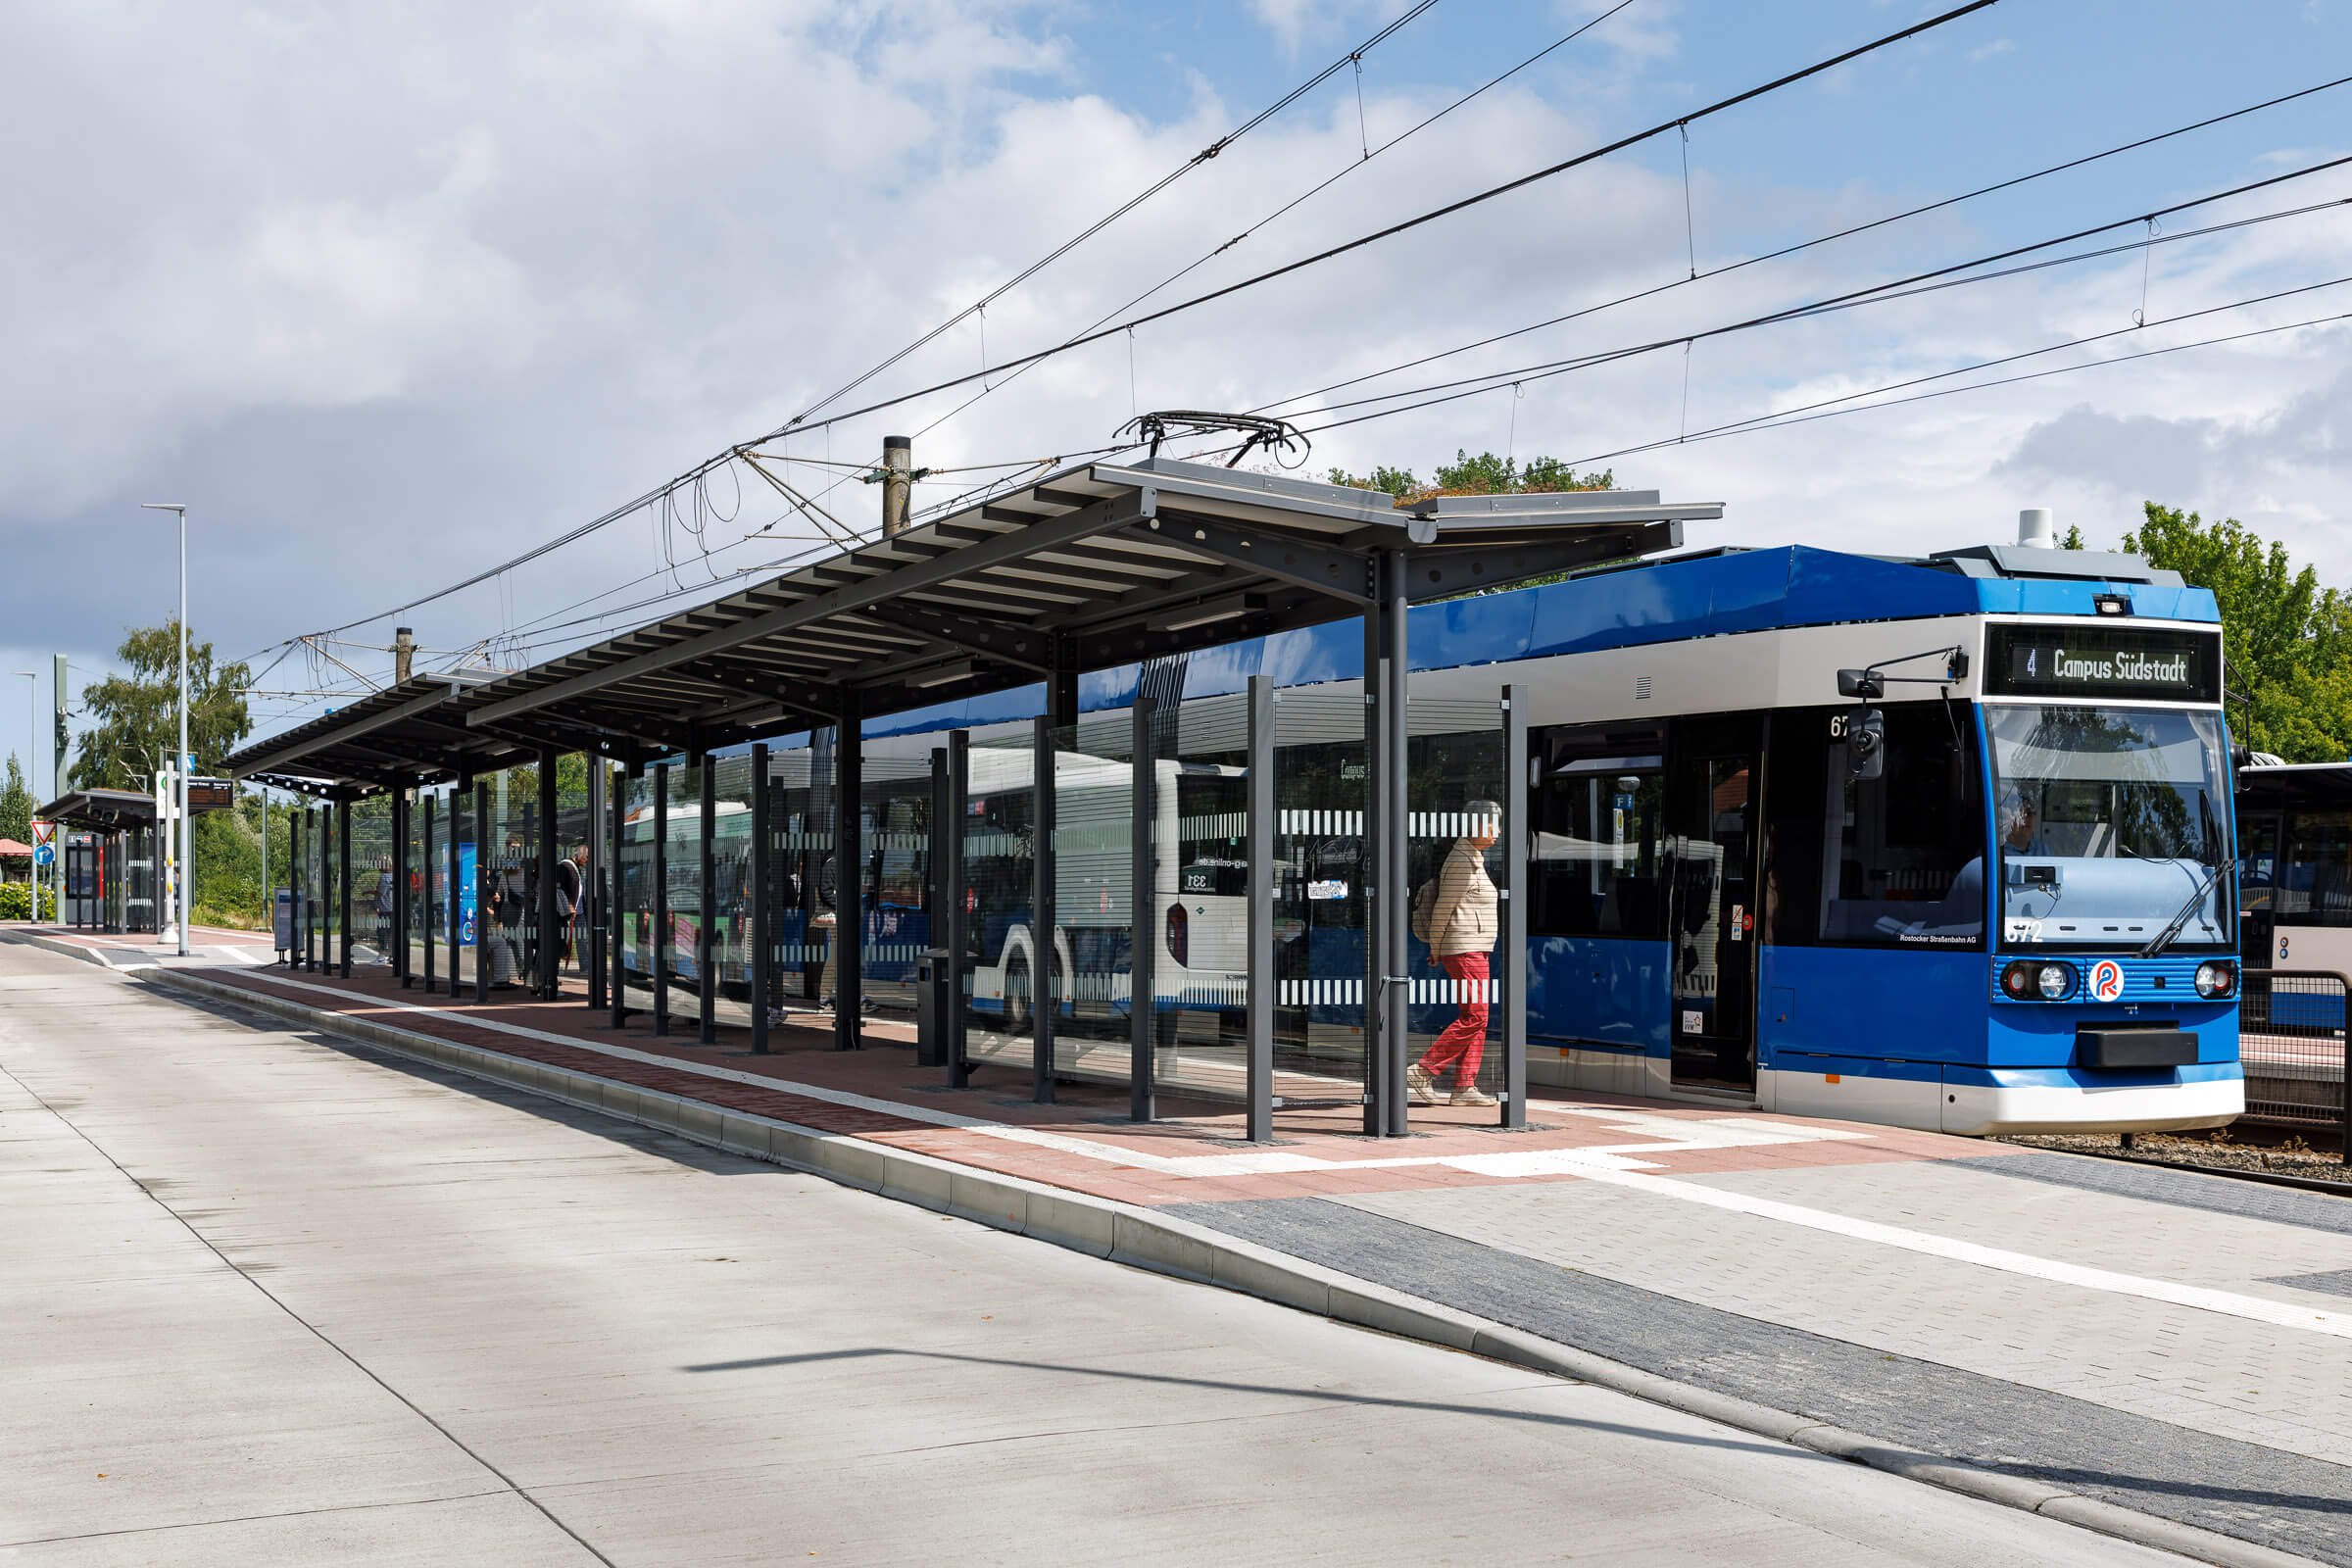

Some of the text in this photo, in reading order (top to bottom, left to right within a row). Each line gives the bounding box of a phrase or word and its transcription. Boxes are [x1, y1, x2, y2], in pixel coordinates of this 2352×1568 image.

[2027, 648, 2186, 682] 4 Campus Südstadt
[1831, 715, 1849, 737] 67
[1899, 934, 1929, 943] Rostocker
[1930, 935, 1966, 944] Straßenbahn
[2006, 919, 2044, 943] 672
